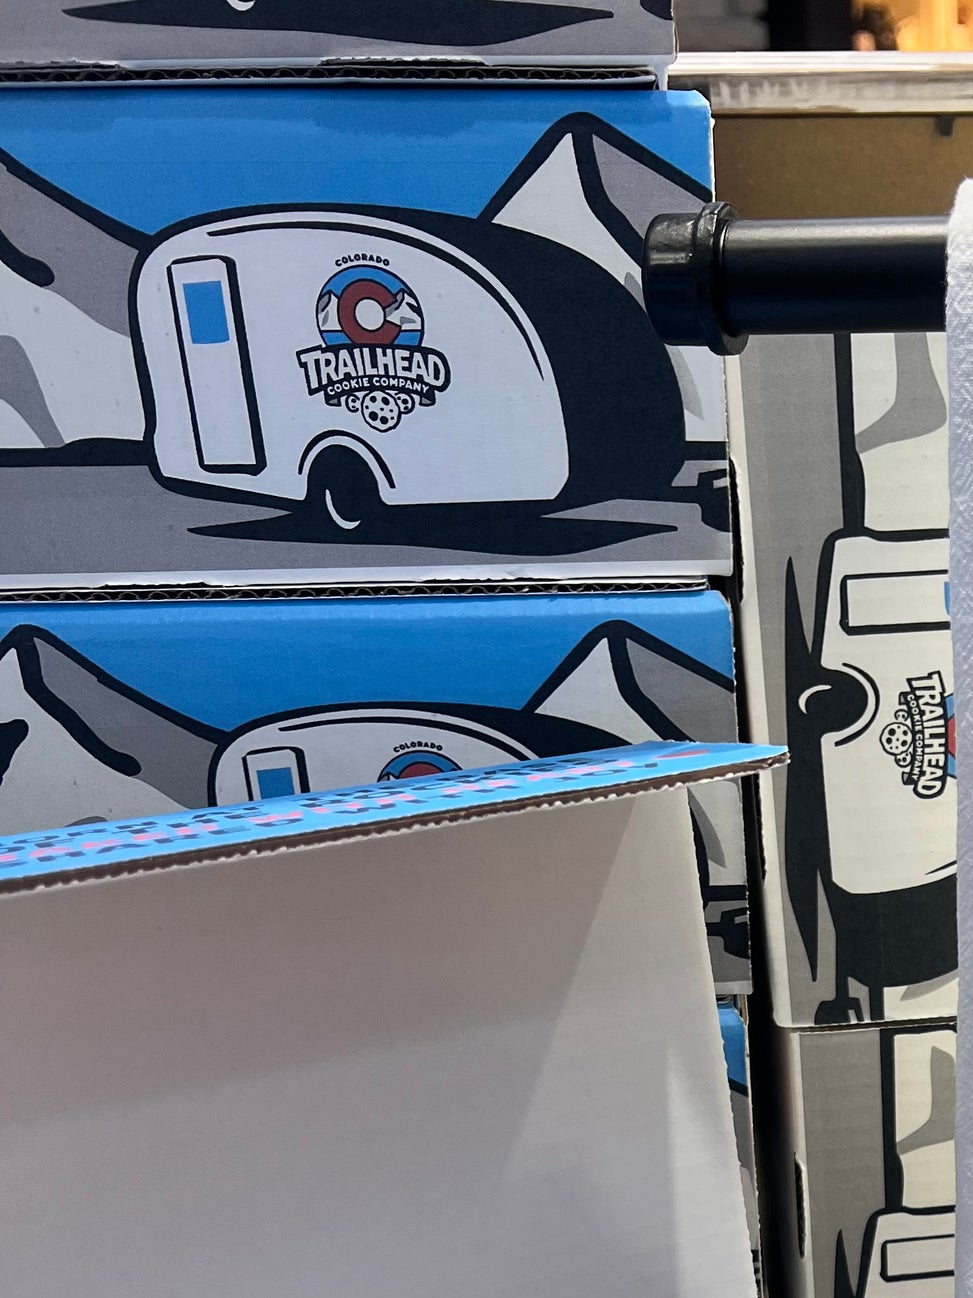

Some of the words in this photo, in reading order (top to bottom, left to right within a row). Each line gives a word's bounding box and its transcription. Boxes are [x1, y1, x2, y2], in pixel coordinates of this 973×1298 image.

[335, 253, 390, 267] COLORADO
[299, 347, 446, 390] TRAILHEAD
[327, 377, 371, 395] COOKIE
[373, 377, 430, 394] COMPANY
[907, 694, 922, 732] COOKIE
[393, 741, 443, 753] COLORADO
[911, 674, 946, 795] TRAILHEAD
[911, 733, 923, 781] COMPANY
